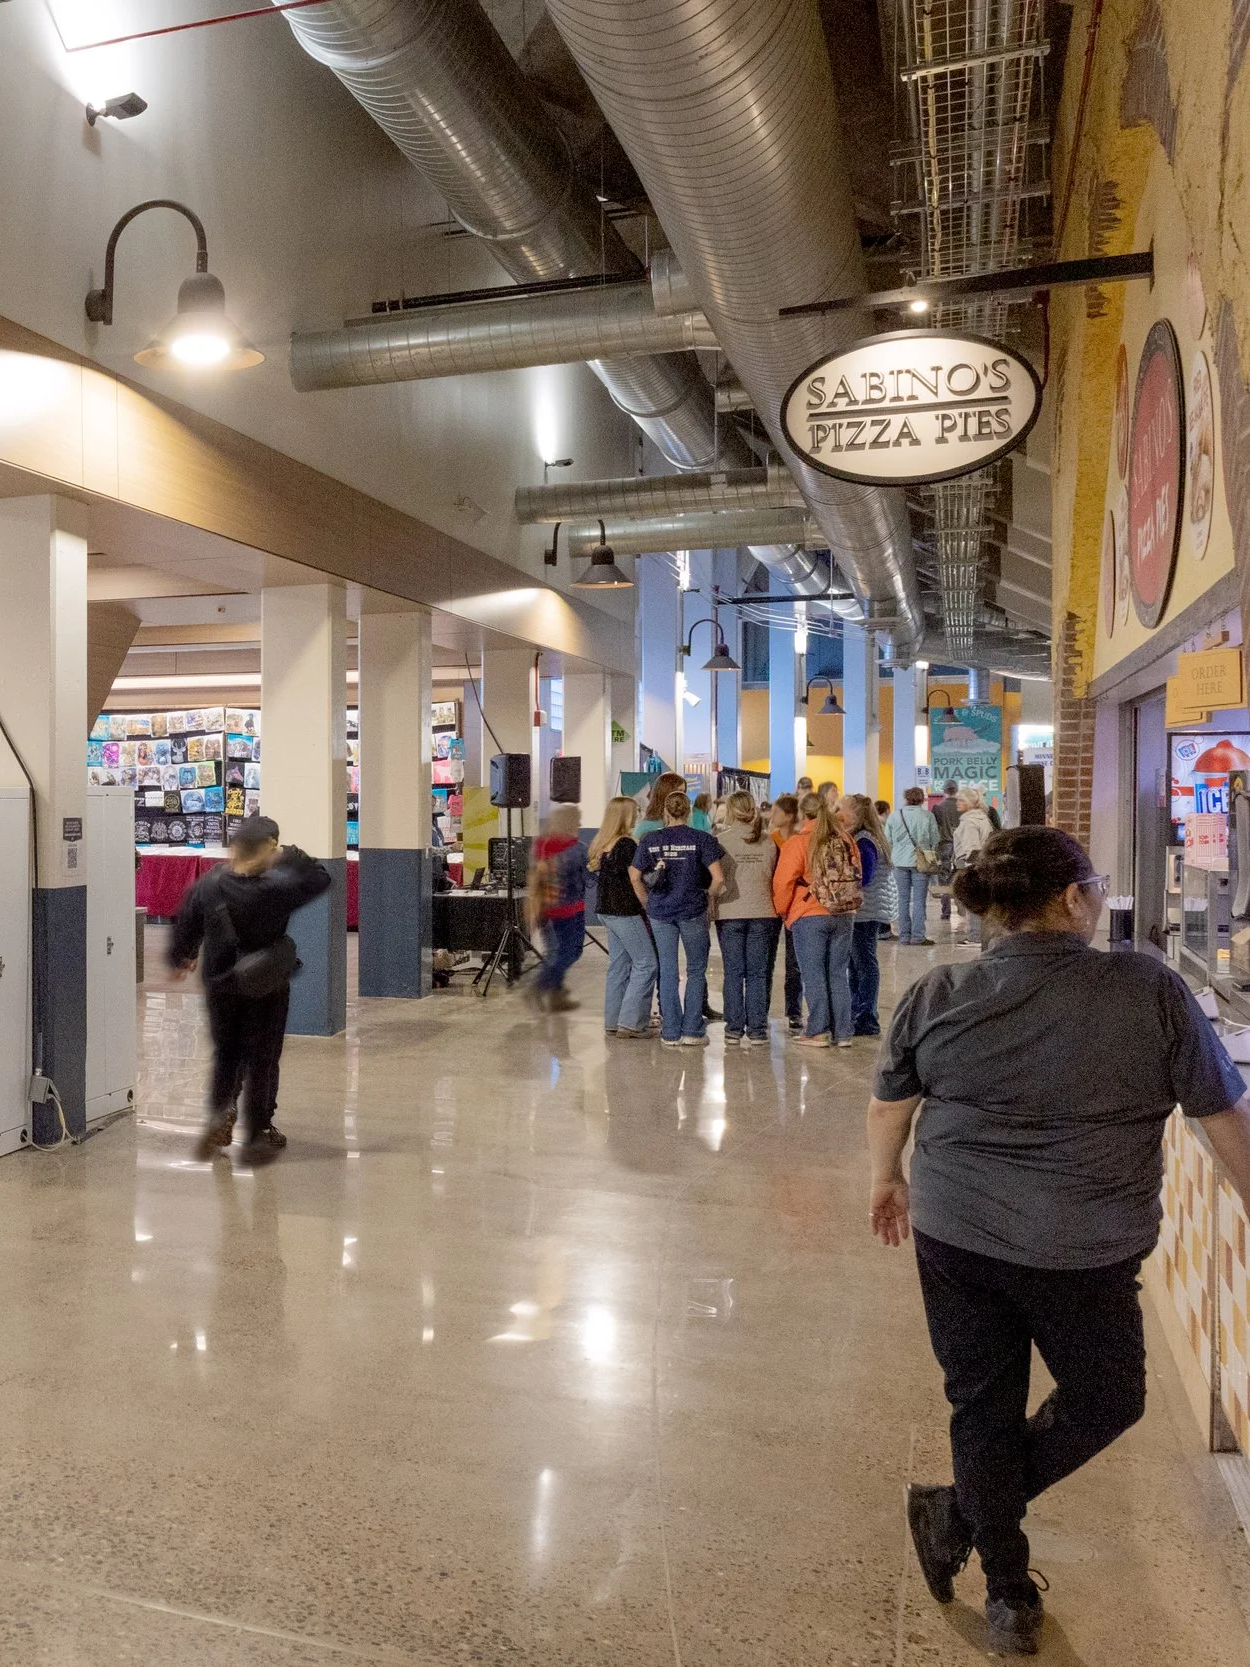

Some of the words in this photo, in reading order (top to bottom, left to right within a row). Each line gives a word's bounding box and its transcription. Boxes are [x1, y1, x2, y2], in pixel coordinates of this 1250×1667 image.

[806, 358, 1012, 411] SABINO'S
[807, 416, 922, 455] PIZZA
[934, 408, 1013, 444] PIES
[1191, 664, 1226, 681] ORDER
[1197, 680, 1223, 696] HERE
[971, 709, 998, 723] SPUDS
[611, 729, 625, 737] TM
[934, 757, 963, 766] PORK
[967, 757, 998, 766] BELLY
[934, 766, 998, 780] MAGIC
